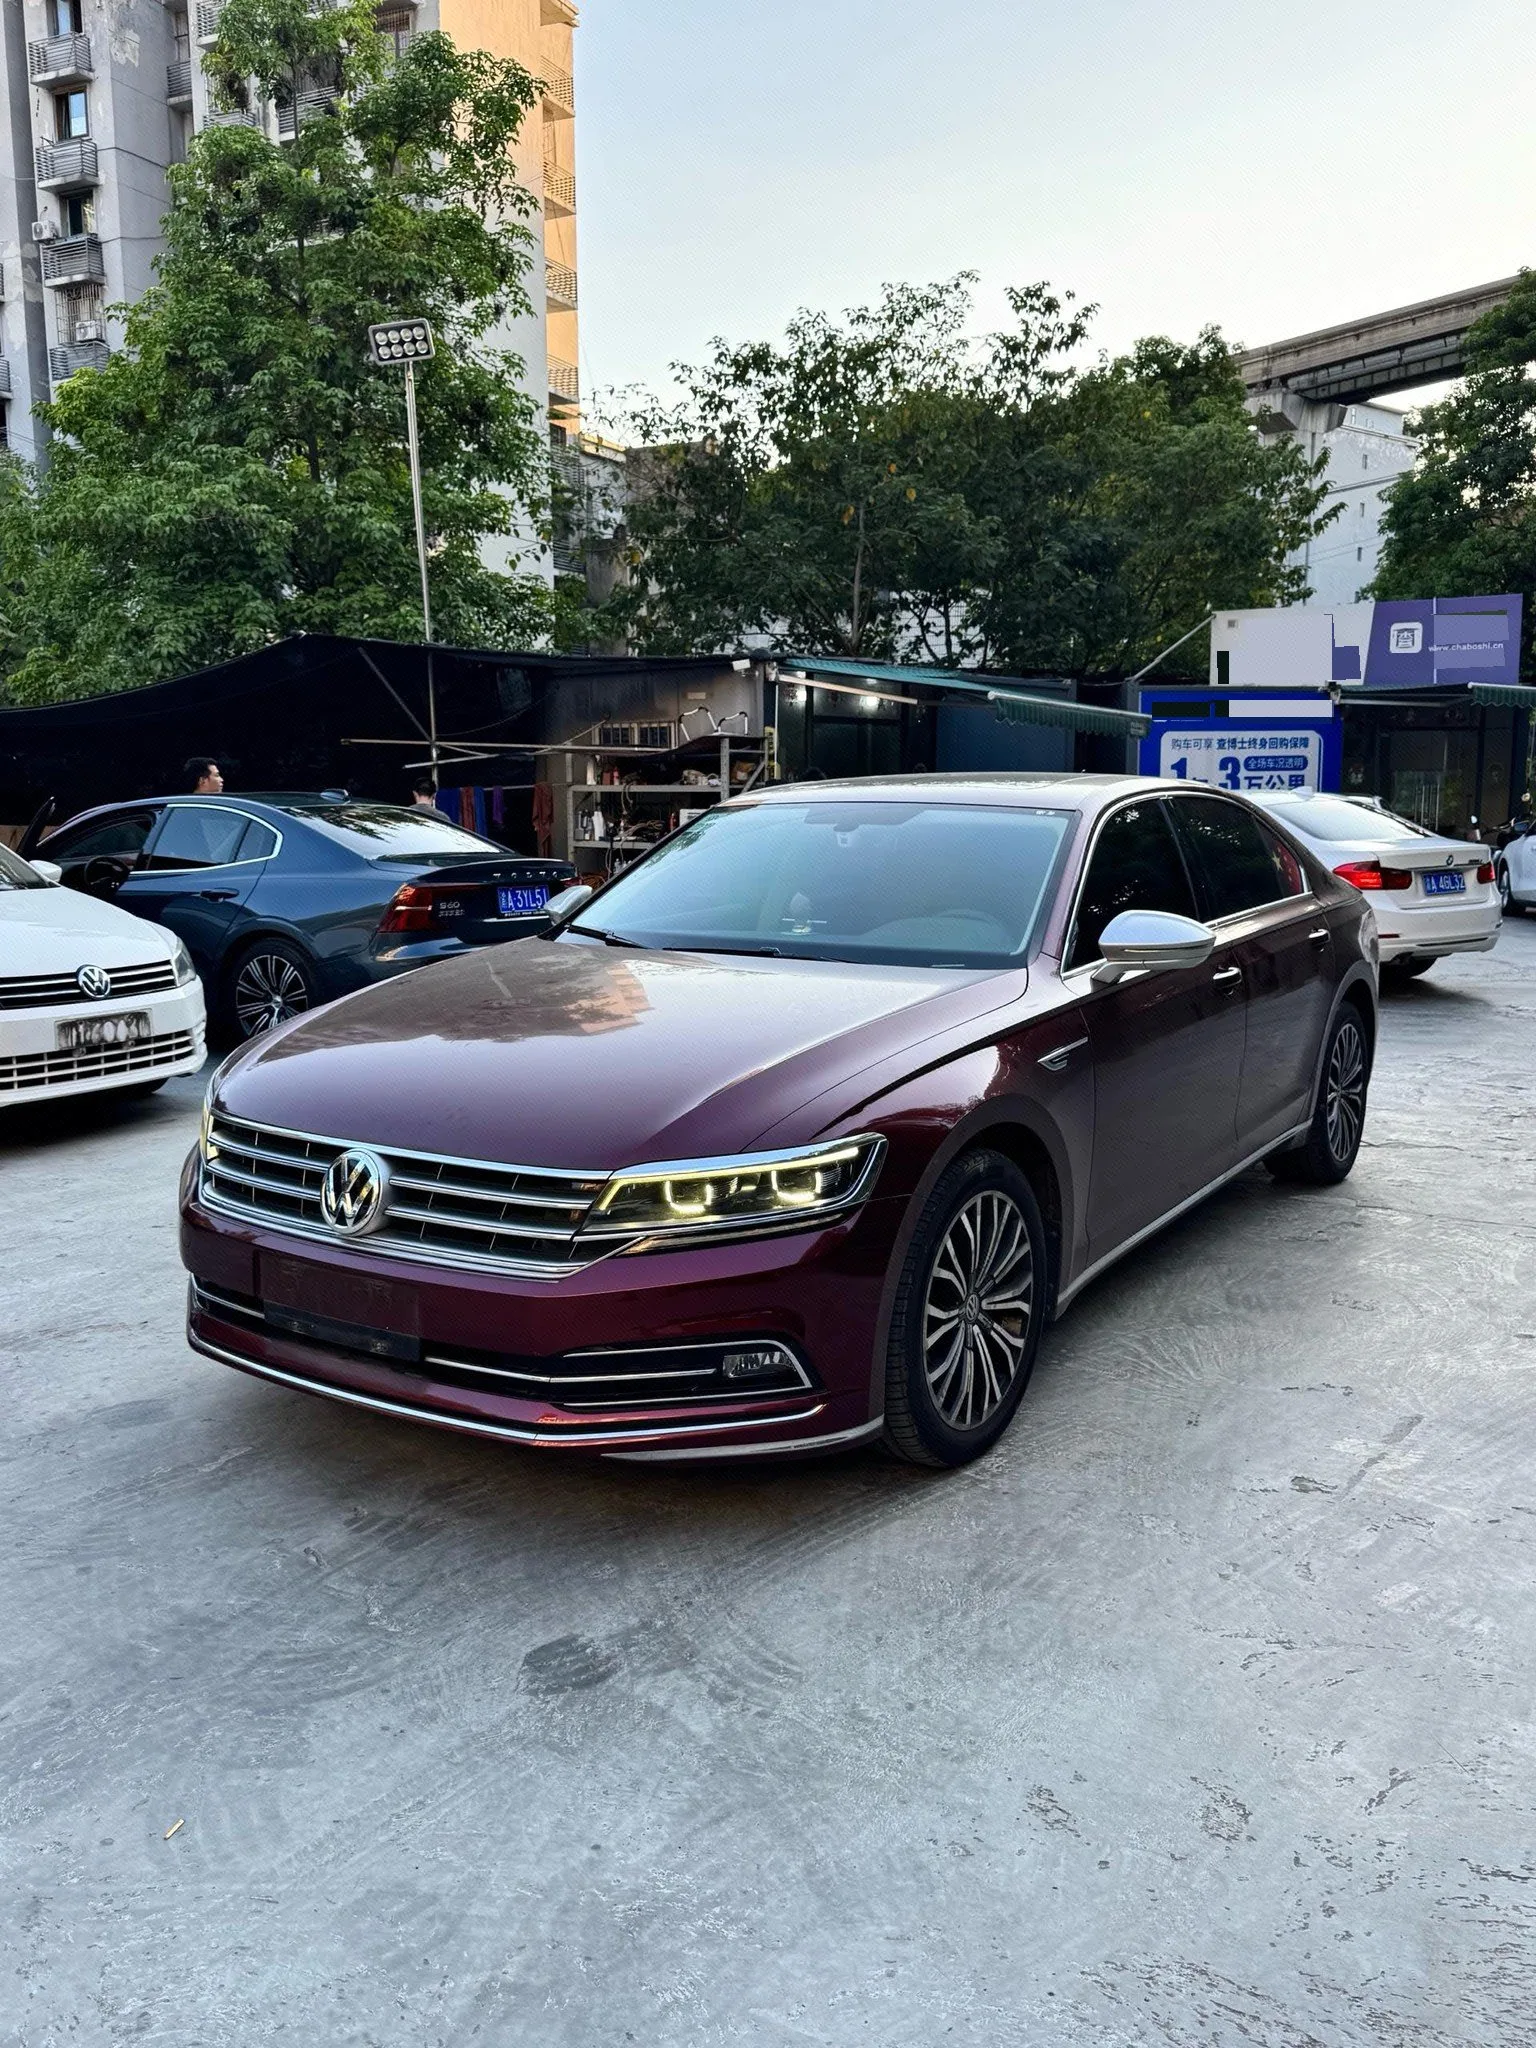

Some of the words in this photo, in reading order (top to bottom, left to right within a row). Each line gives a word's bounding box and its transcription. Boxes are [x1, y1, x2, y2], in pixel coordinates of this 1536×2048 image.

[1428, 642, 1504, 652] www.chaboshi.cn
[1171, 738, 1213, 750] 购车可享
[1216, 737, 1309, 750] 查博士终身回购保障
[440, 901, 461, 909] S60
